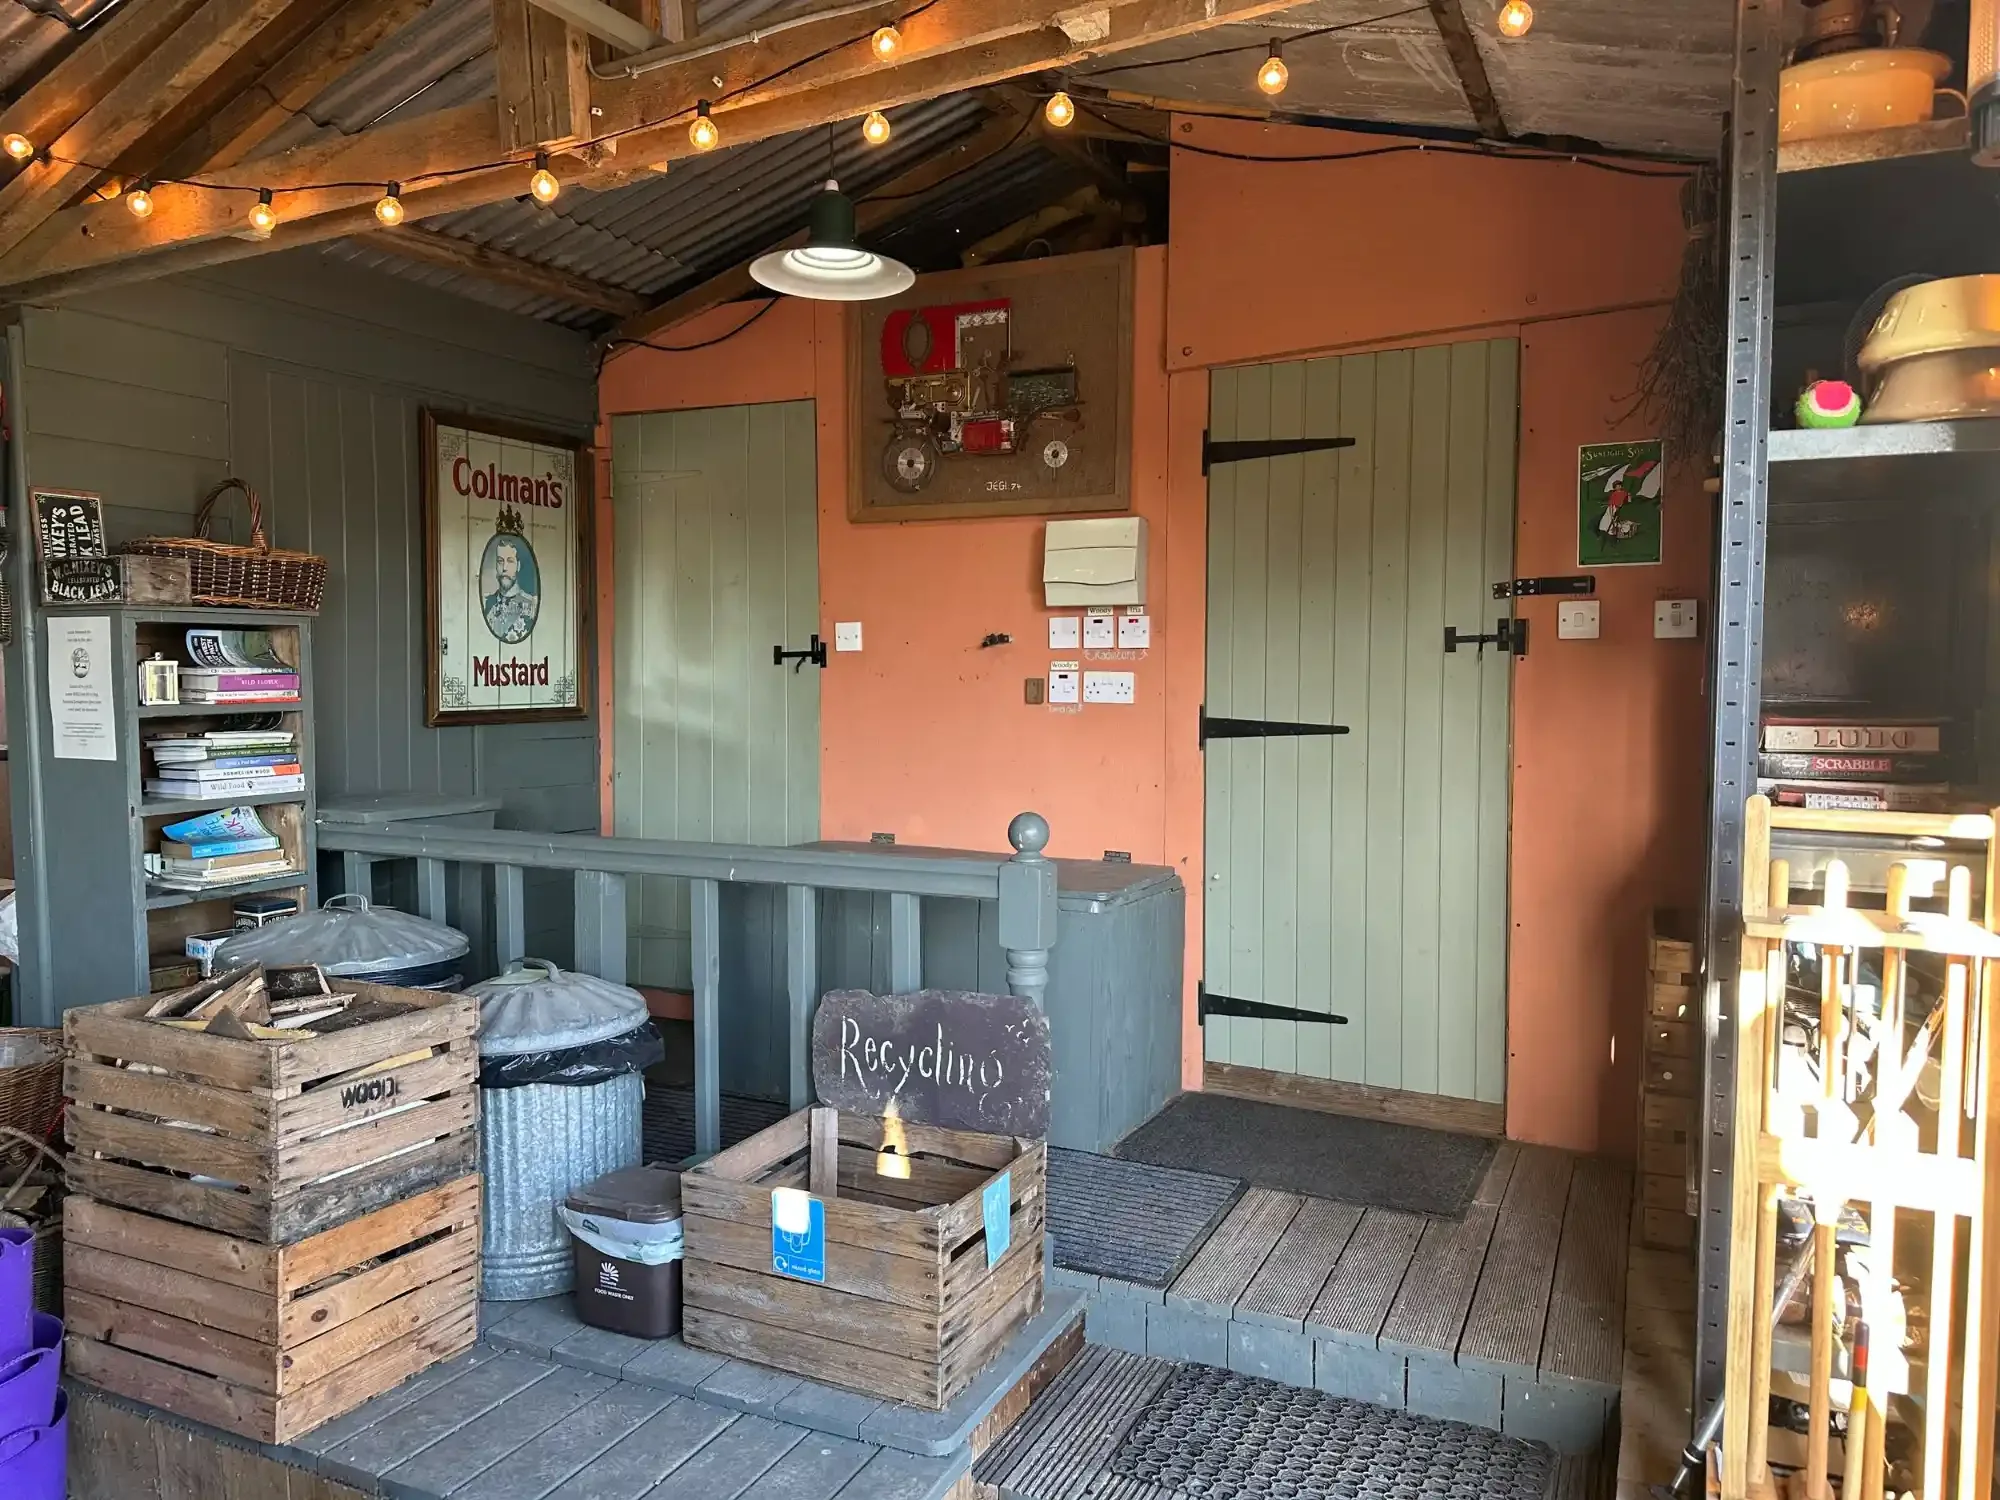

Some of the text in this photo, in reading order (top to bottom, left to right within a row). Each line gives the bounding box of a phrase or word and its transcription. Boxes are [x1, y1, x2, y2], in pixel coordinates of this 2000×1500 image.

[453, 457, 563, 508] Colman's
[69, 505, 91, 541] LEAD
[92, 519, 100, 544] WASTE
[51, 579, 85, 600] BLACK
[473, 656, 549, 687] Mustard
[1814, 728, 1916, 748] LUDO
[1815, 758, 1889, 770] SCRABBLE
[210, 781, 245, 790] Wild Food
[841, 1015, 1011, 1119] Recycling
[594, 1287, 608, 1295] FOOD
[608, 1290, 621, 1299] WASTE
